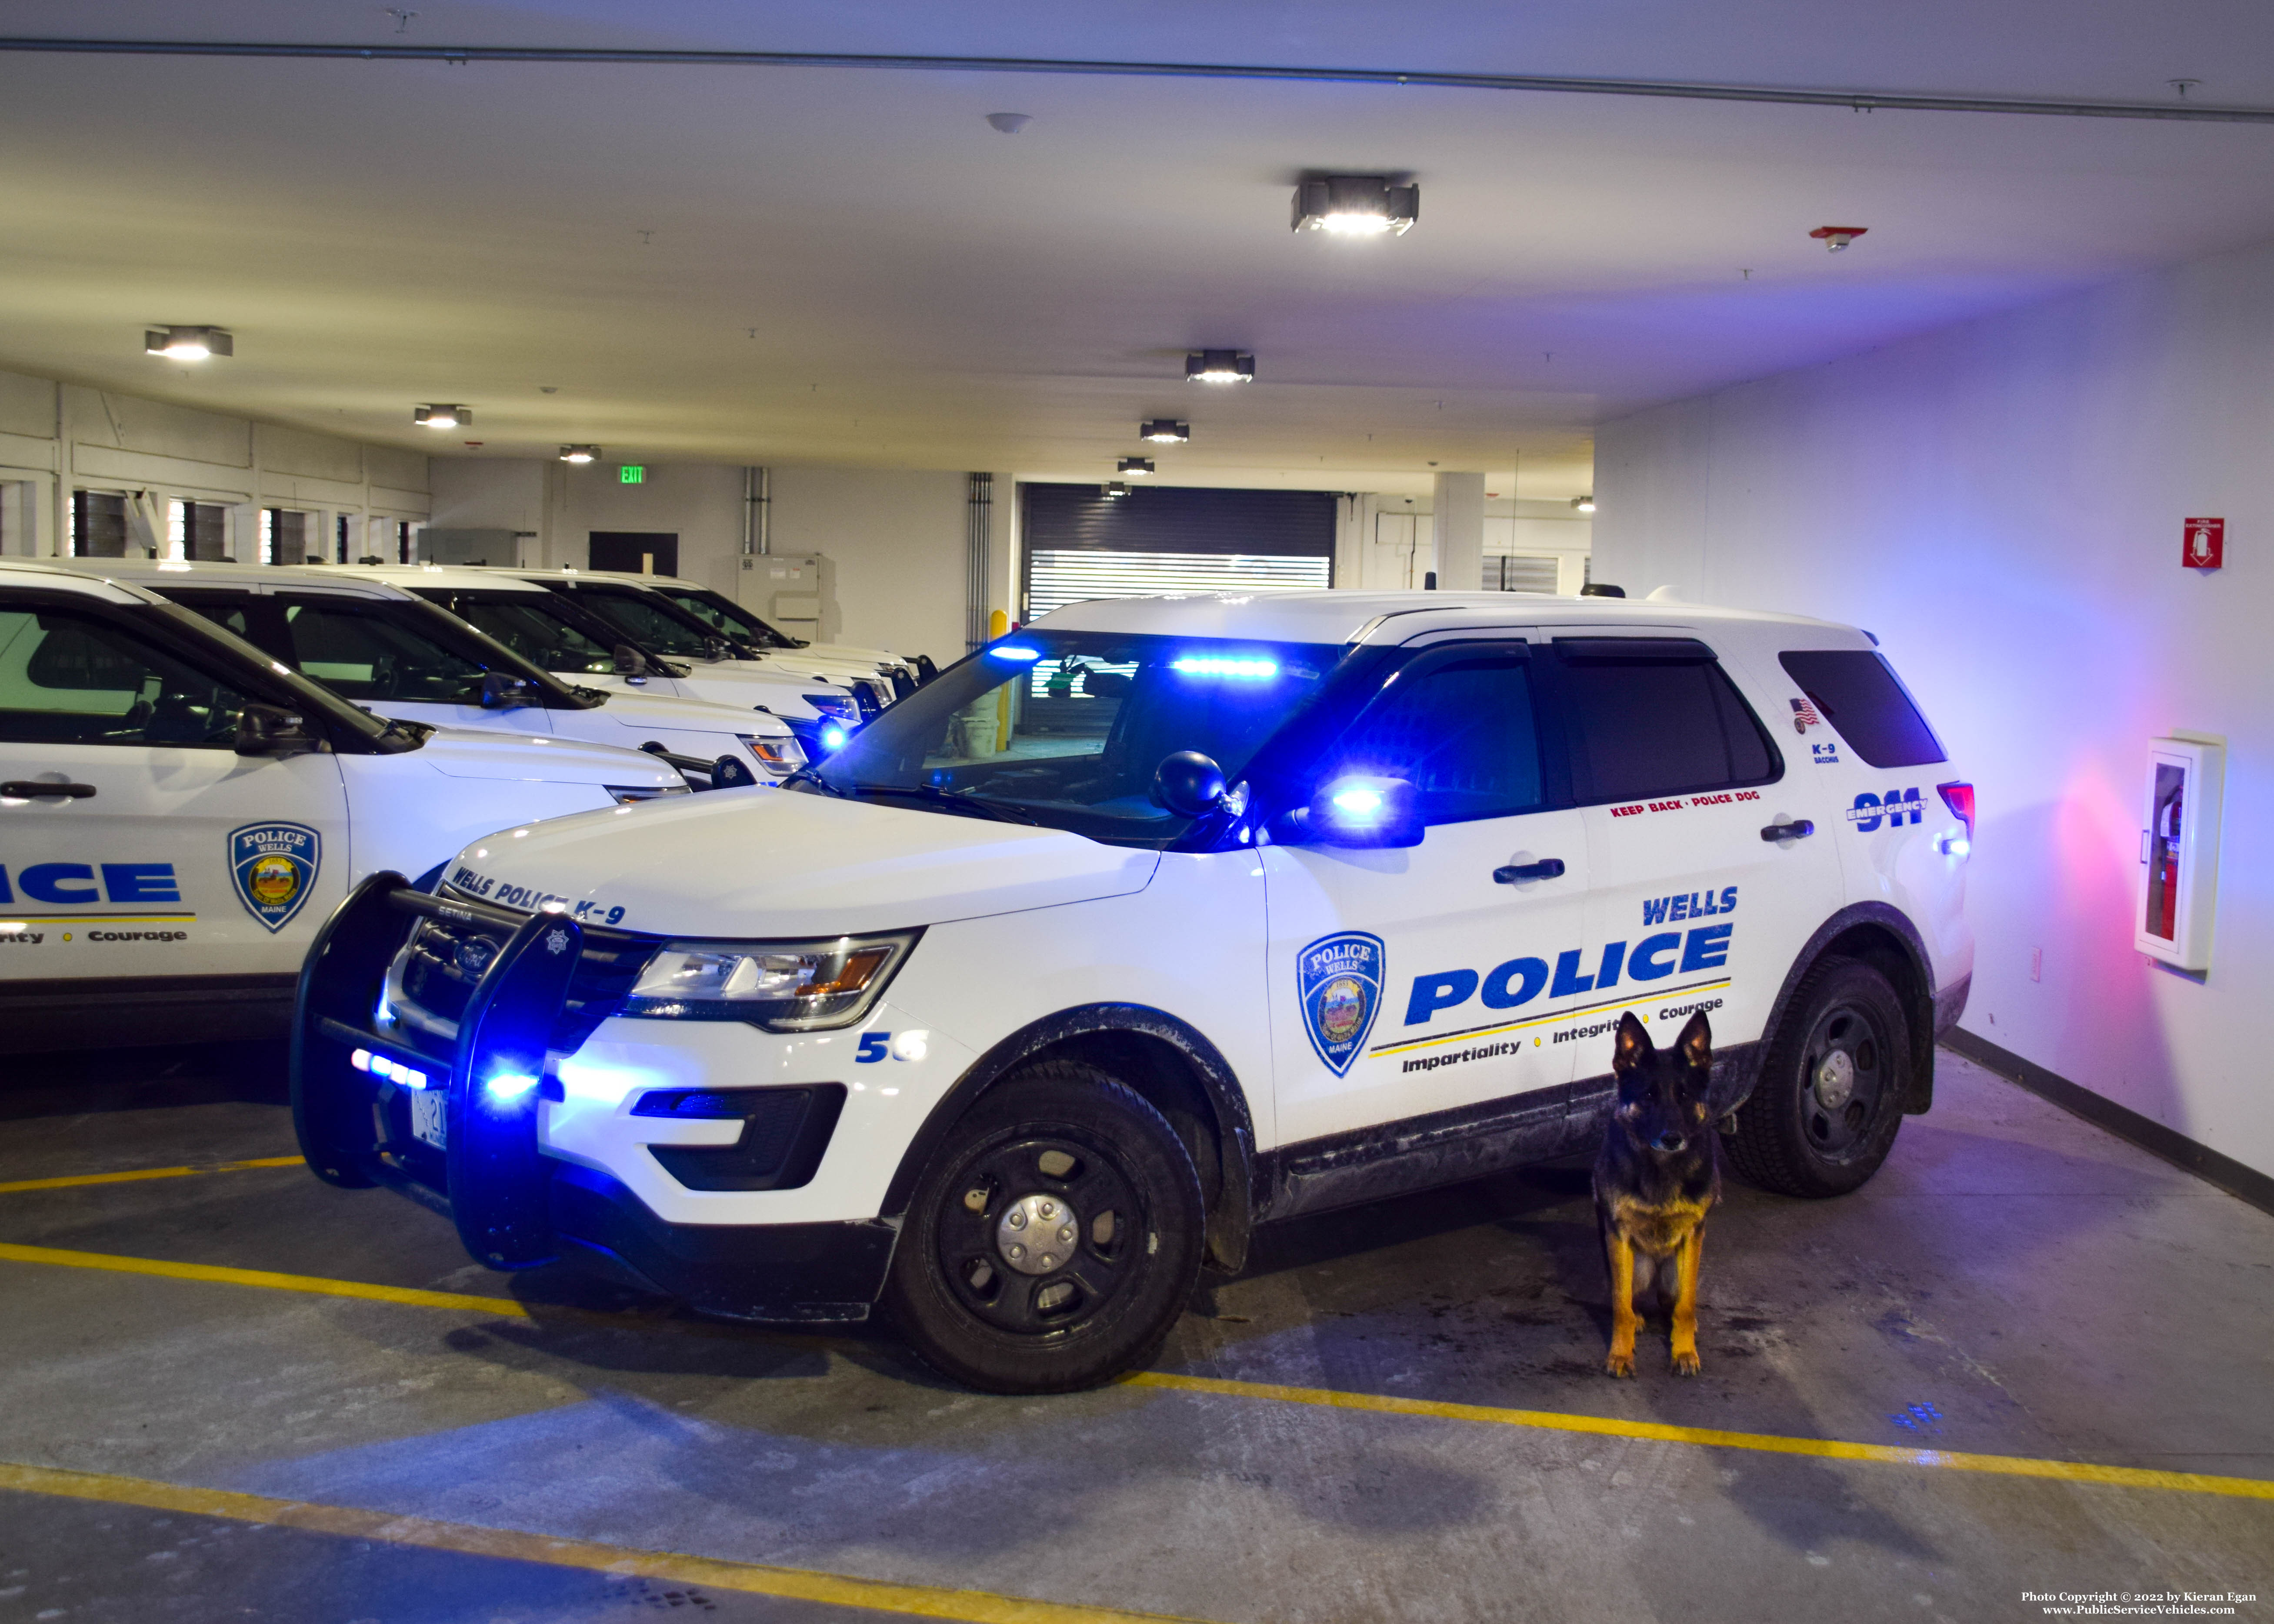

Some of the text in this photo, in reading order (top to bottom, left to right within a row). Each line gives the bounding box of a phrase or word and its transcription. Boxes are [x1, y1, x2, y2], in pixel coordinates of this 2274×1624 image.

[622, 466, 644, 484] EXIT
[1812, 744, 1835, 754] K-9
[1610, 790, 1760, 817] KEEP BACK POLICE DOG
[1847, 798, 1928, 821] EMERGENCY
[1854, 787, 1922, 832] 911
[243, 831, 307, 847] POLICE
[258, 843, 292, 852] WELLS
[453, 867, 495, 896] WELLS
[574, 900, 626, 925] K-9
[439, 906, 472, 921] SETINA
[1643, 886, 1738, 927] WELLS
[88, 930, 187, 942] Courage
[1311, 944, 1371, 970] POLICE
[1326, 960, 1357, 975] WELLS
[1404, 922, 1734, 1027] POLICE
[1402, 998, 1723, 1073] Impartiality Integrit Courage
[1329, 1041, 1352, 1054] MAINE
